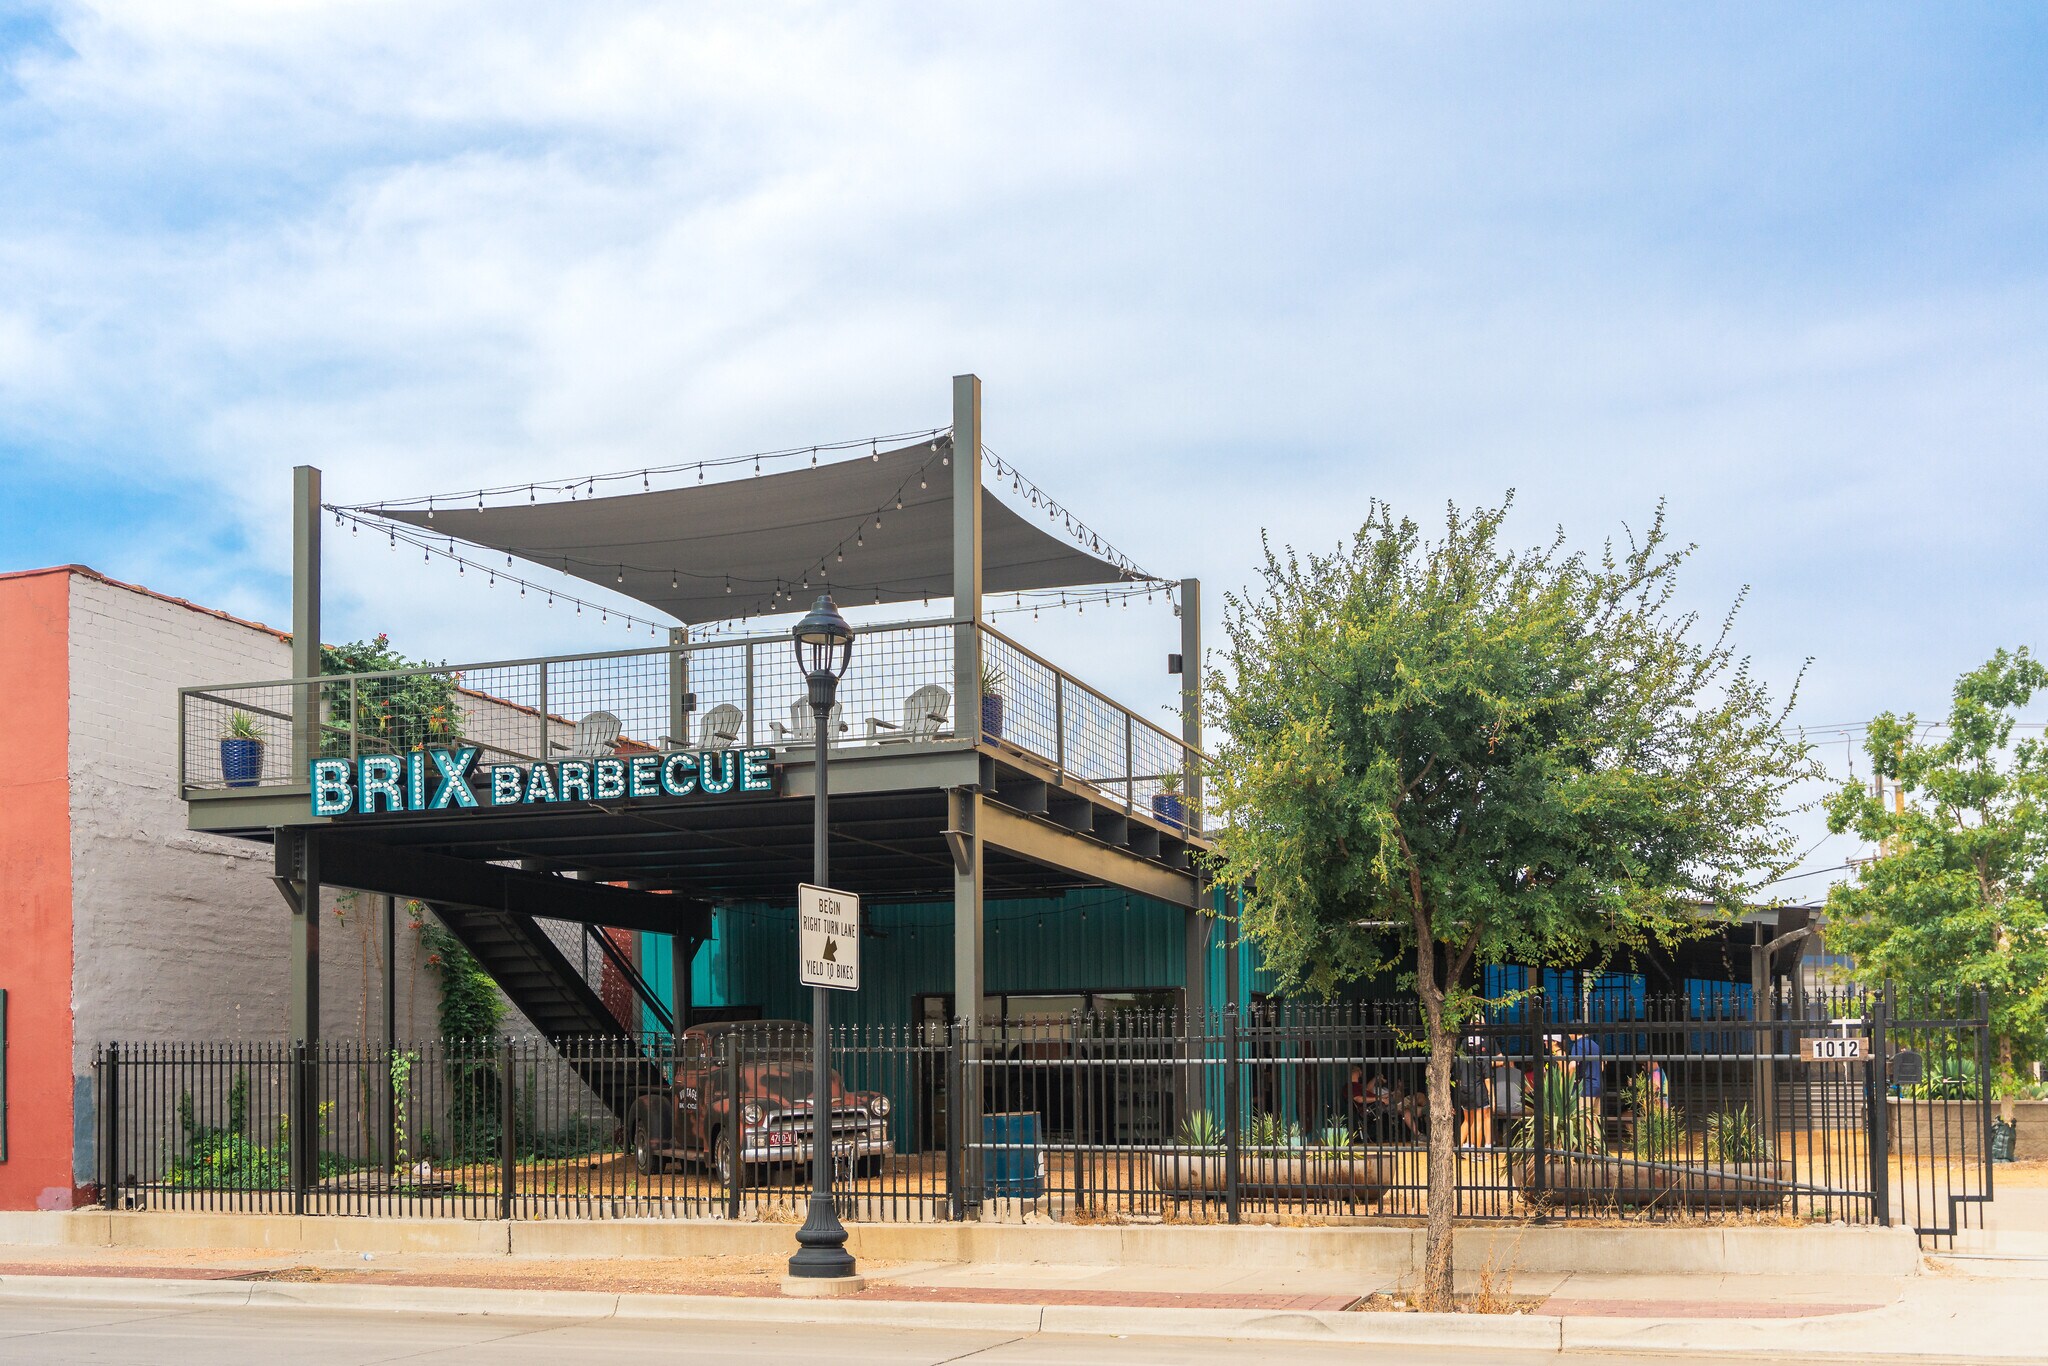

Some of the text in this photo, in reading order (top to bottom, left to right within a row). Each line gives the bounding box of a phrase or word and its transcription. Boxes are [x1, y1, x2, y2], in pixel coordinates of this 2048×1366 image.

[310, 747, 772, 816] BRIX BARBECUE
[818, 898, 841, 916] BEGIN
[803, 915, 856, 939] RIGHT TURN LANE
[806, 960, 854, 980] YIELD TO BIKES
[1815, 1041, 1858, 1058] 1012
